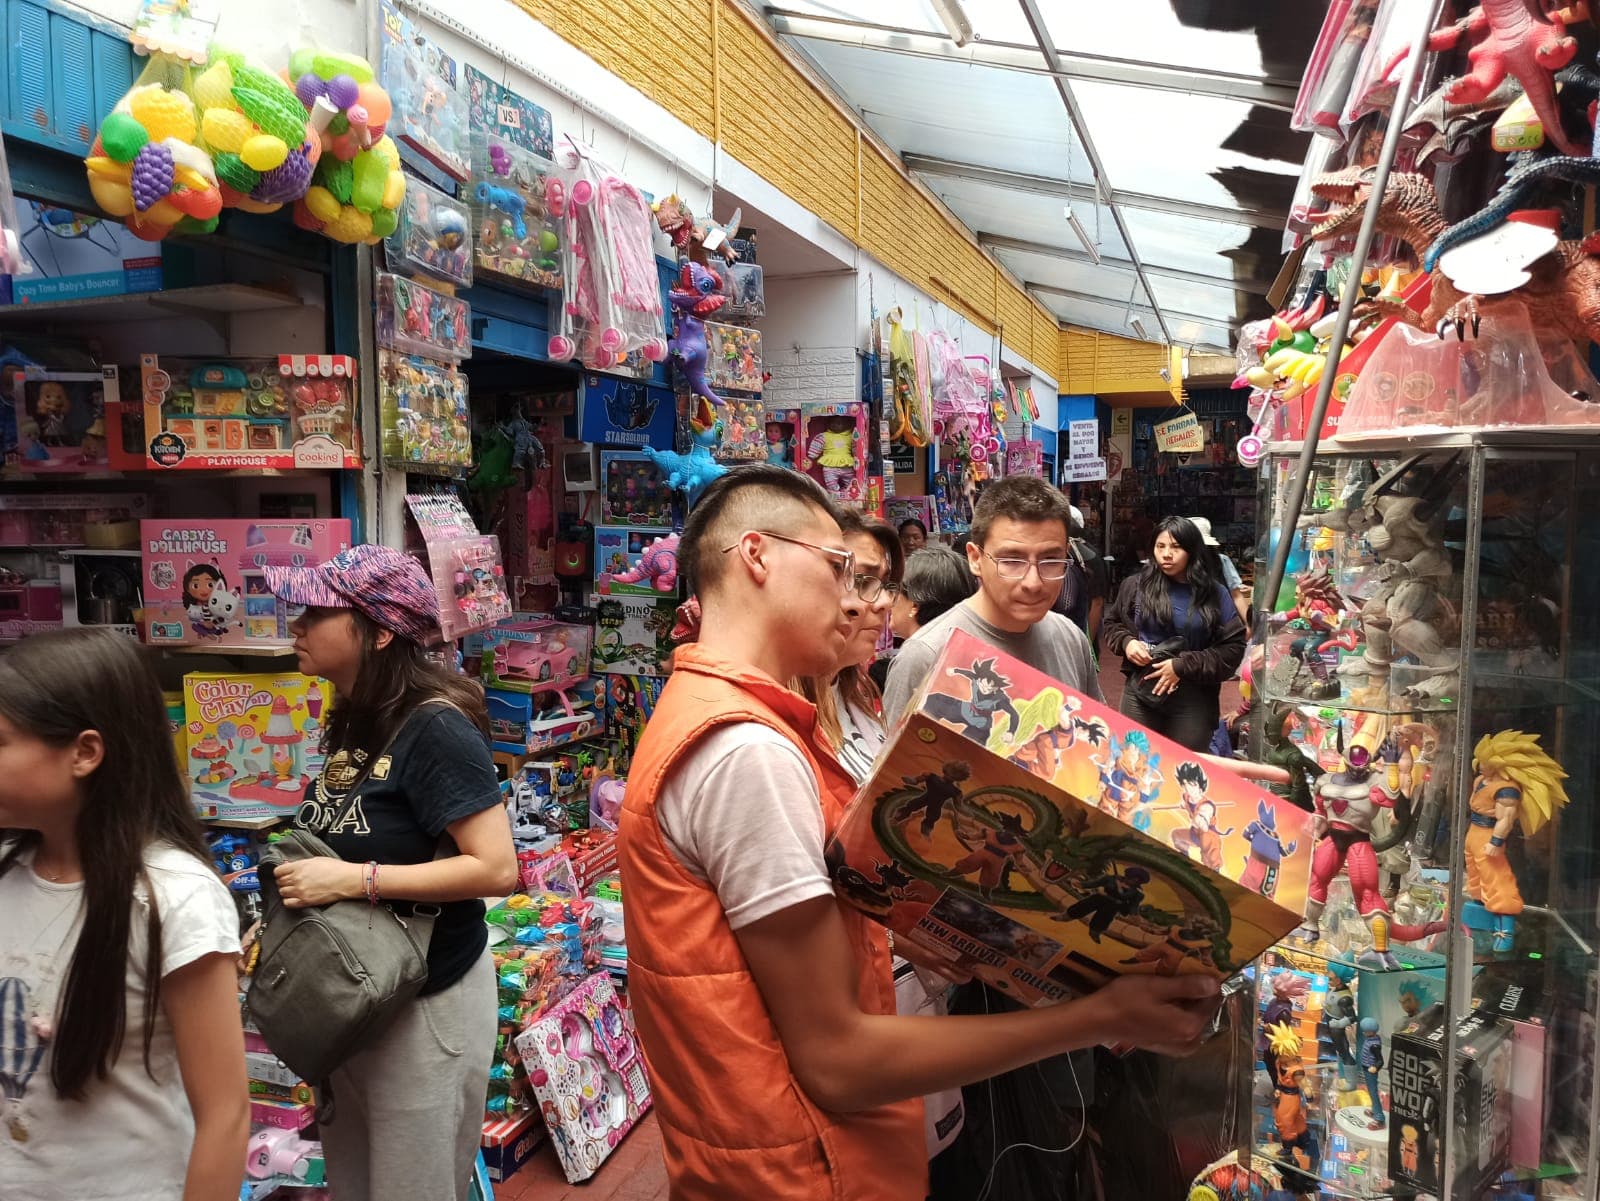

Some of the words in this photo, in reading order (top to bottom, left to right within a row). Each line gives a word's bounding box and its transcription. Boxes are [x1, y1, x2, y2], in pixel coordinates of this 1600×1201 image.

[502, 109, 517, 124] VS.
[18, 285, 37, 296] Cozy
[38, 283, 57, 293] Time
[58, 281, 84, 293] Baby's
[86, 277, 121, 289] Bouncer
[1165, 429, 1196, 446] REGALOS
[207, 457, 232, 466] PLAY
[233, 457, 268, 466] HOUSE
[299, 452, 339, 464] Cooking
[1072, 471, 1100, 479] REGALOS
[161, 528, 216, 541] GABBY'S
[149, 540, 228, 555] DOLLHOUSE
[625, 605, 651, 615] DINO
[490, 629, 530, 641] WEDDING
[193, 679, 253, 704] Color
[250, 693, 270, 705] DIY
[201, 697, 251, 723] Clay
[918, 917, 949, 939] NEW
[1011, 966, 1070, 1001] COLLECT
